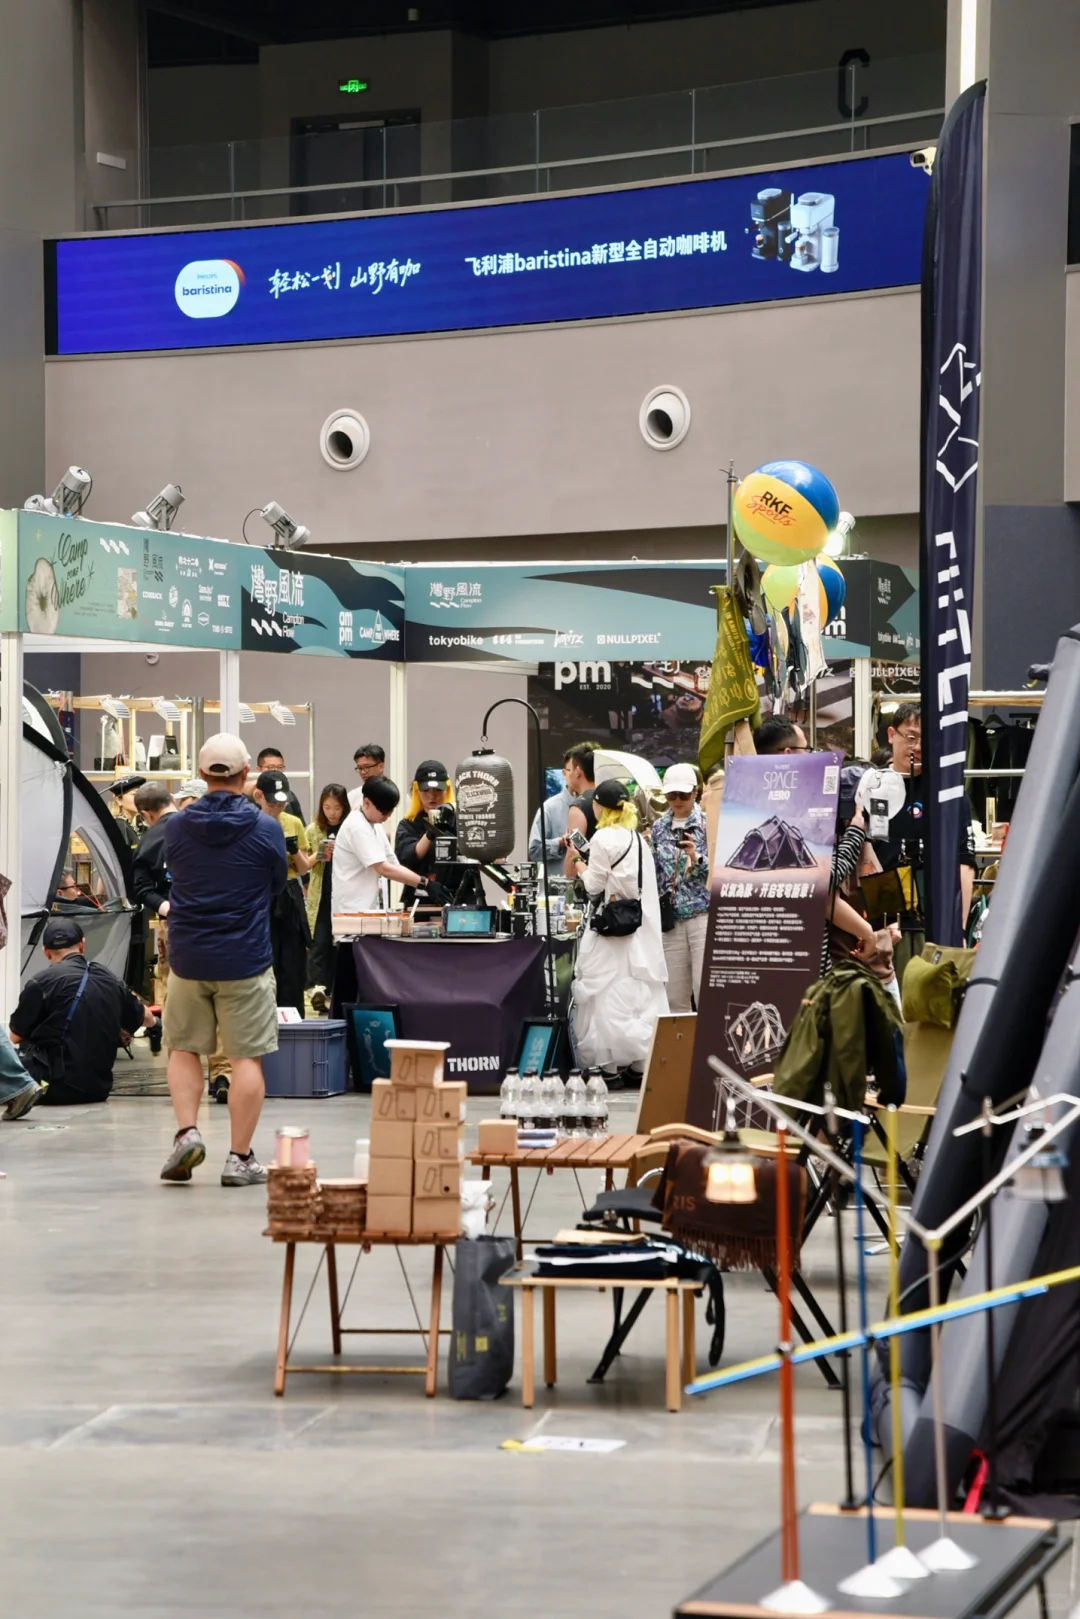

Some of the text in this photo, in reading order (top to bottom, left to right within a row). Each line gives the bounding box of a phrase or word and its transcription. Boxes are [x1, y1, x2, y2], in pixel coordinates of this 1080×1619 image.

[838, 48, 871, 118] C
[465, 230, 728, 277] 飞利浦baristina新型全自动咖啡机
[350, 257, 421, 294] 山野有咖
[182, 284, 232, 297] baristina
[747, 495, 797, 526] Sports
[760, 491, 793, 515] RKF
[58, 532, 88, 571] Camp
[339, 611, 353, 626] am
[339, 627, 353, 646] pm
[360, 627, 373, 639] CAMP
[384, 629, 400, 641] WHERE
[429, 635, 484, 648] tokyobike
[606, 634, 660, 644] NULLPIXEL
[472, 771, 500, 787] THORN
[763, 771, 798, 789] SPACE
[447, 1056, 500, 1072] THORN
